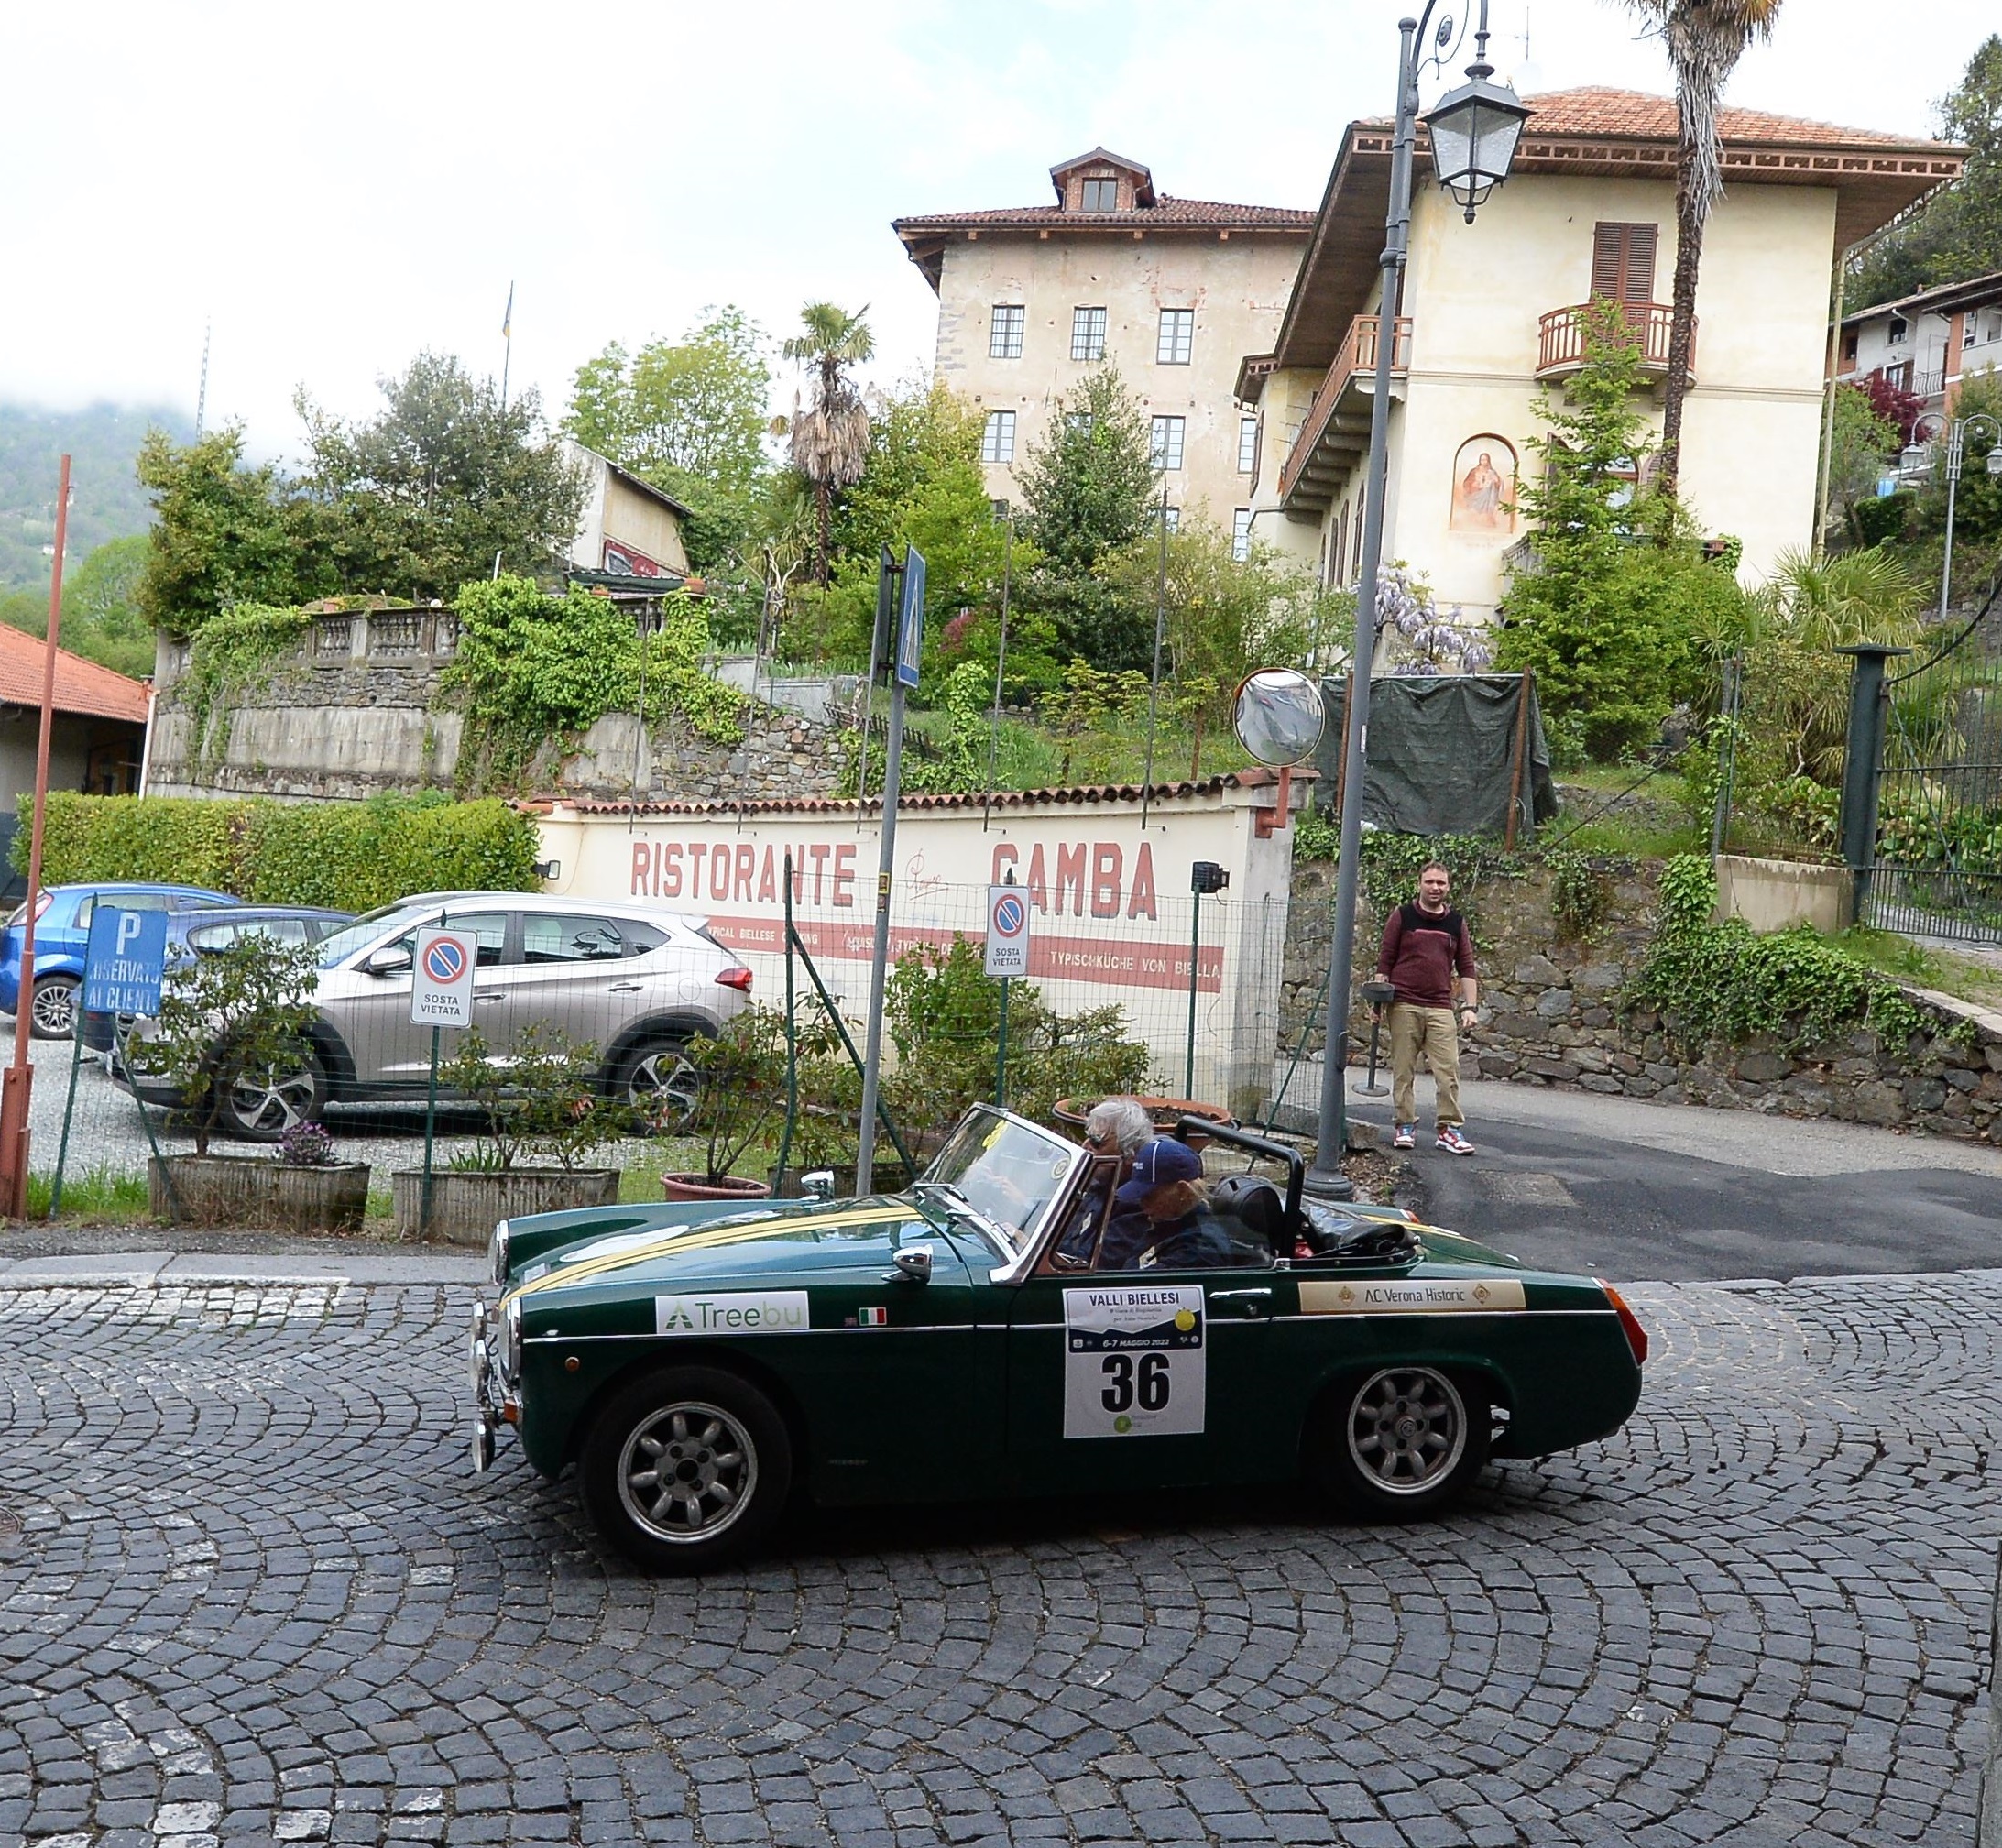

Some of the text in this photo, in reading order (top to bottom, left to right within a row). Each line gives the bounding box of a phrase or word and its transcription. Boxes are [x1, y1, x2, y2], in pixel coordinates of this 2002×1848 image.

[630, 842, 857, 907] RISTORANTE
[991, 842, 1157, 921] GAMBA
[116, 912, 141, 955] P
[706, 926, 818, 945] YPICAL BIELLESE CKING
[995, 947, 1020, 957] SOSTA
[992, 957, 1021, 967] VIETATA
[1142, 957, 1166, 973] VON
[1175, 961, 1220, 978] BIELLA
[88, 987, 101, 1009] AI
[424, 993, 458, 1005] SOSTA
[421, 1005, 460, 1016] VIETATA
[1089, 1292, 1179, 1306] VALLI BIELLESI
[1384, 1288, 1423, 1303] Verona
[1426, 1287, 1466, 1302] Historic
[695, 1300, 802, 1329] Treebu
[1102, 1339, 1118, 1348] 6-7
[1120, 1339, 1150, 1347] MAGGIO
[1101, 1353, 1170, 1412] 36
